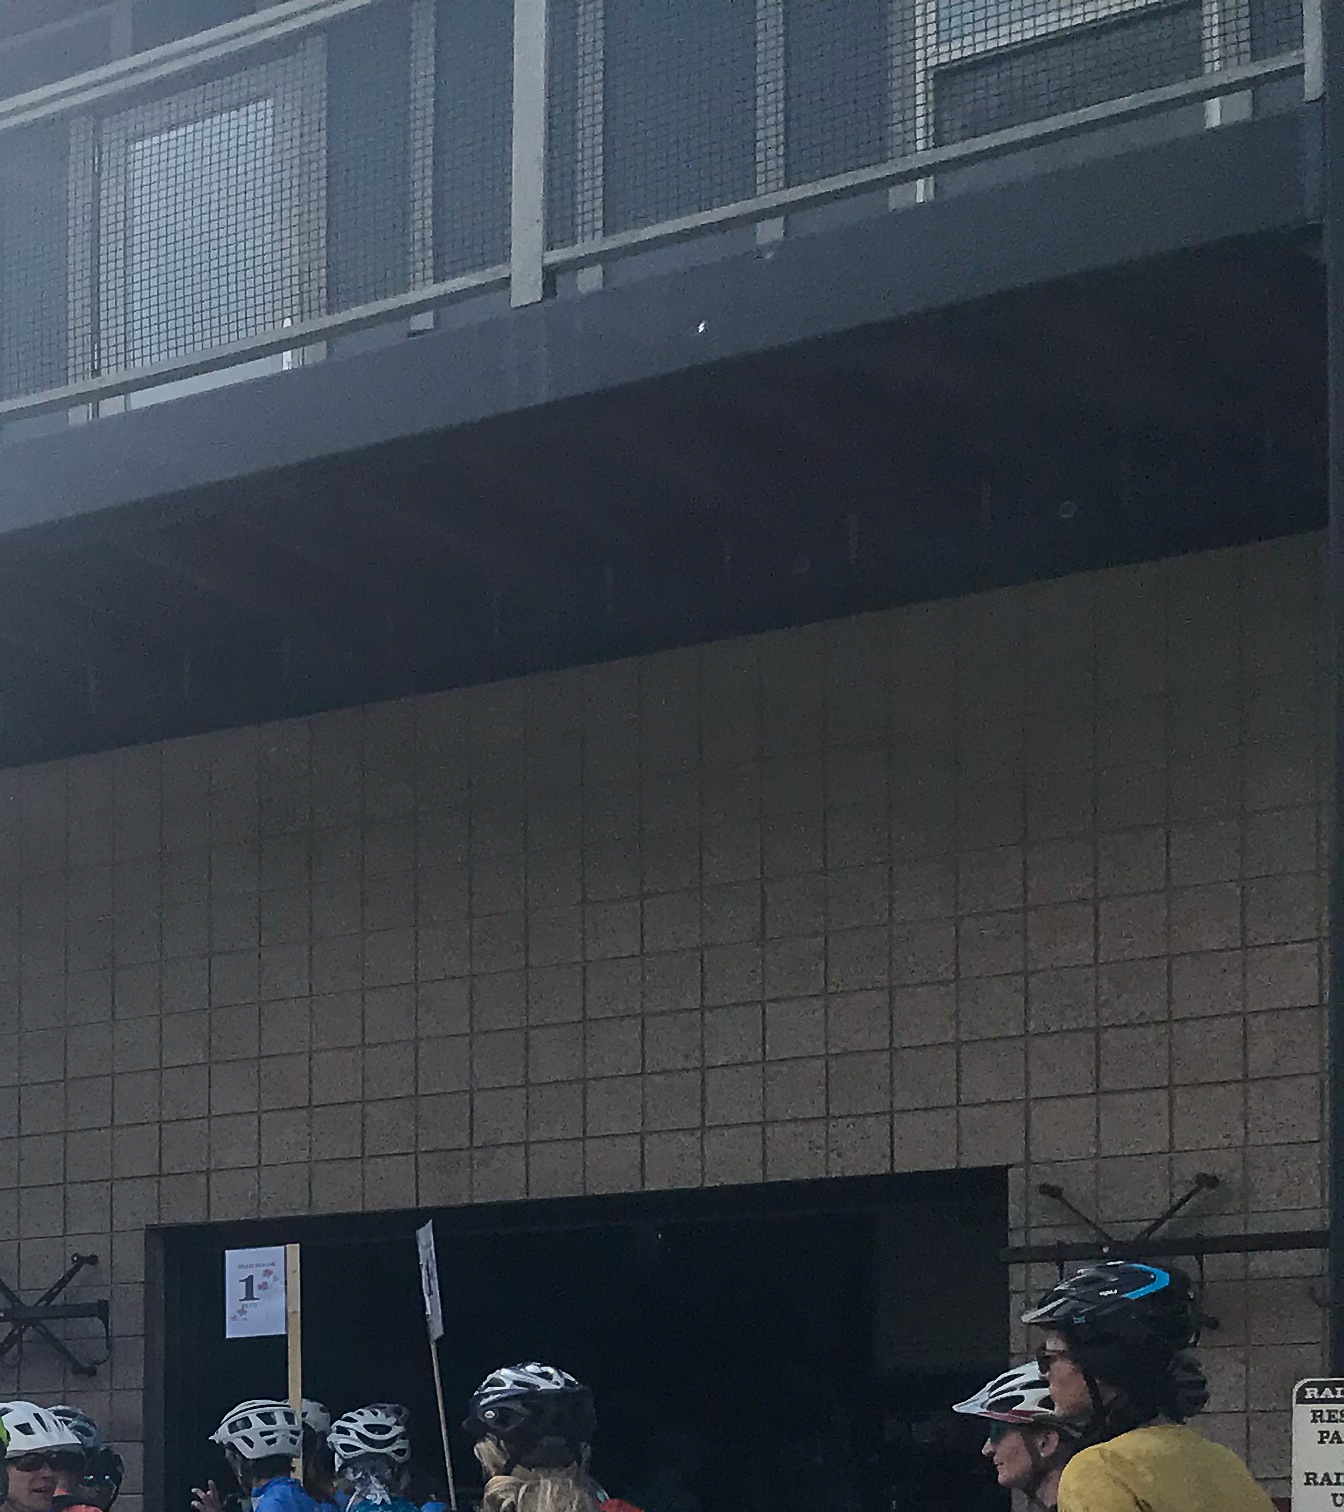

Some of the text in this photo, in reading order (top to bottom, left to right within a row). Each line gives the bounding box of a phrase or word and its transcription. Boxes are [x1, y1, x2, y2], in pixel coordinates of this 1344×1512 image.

[238, 1274, 260, 1302] 1
[1304, 1386, 1344, 1399] RAI
[1317, 1430, 1344, 1444] PA
[1303, 1471, 1344, 1486] RAI
